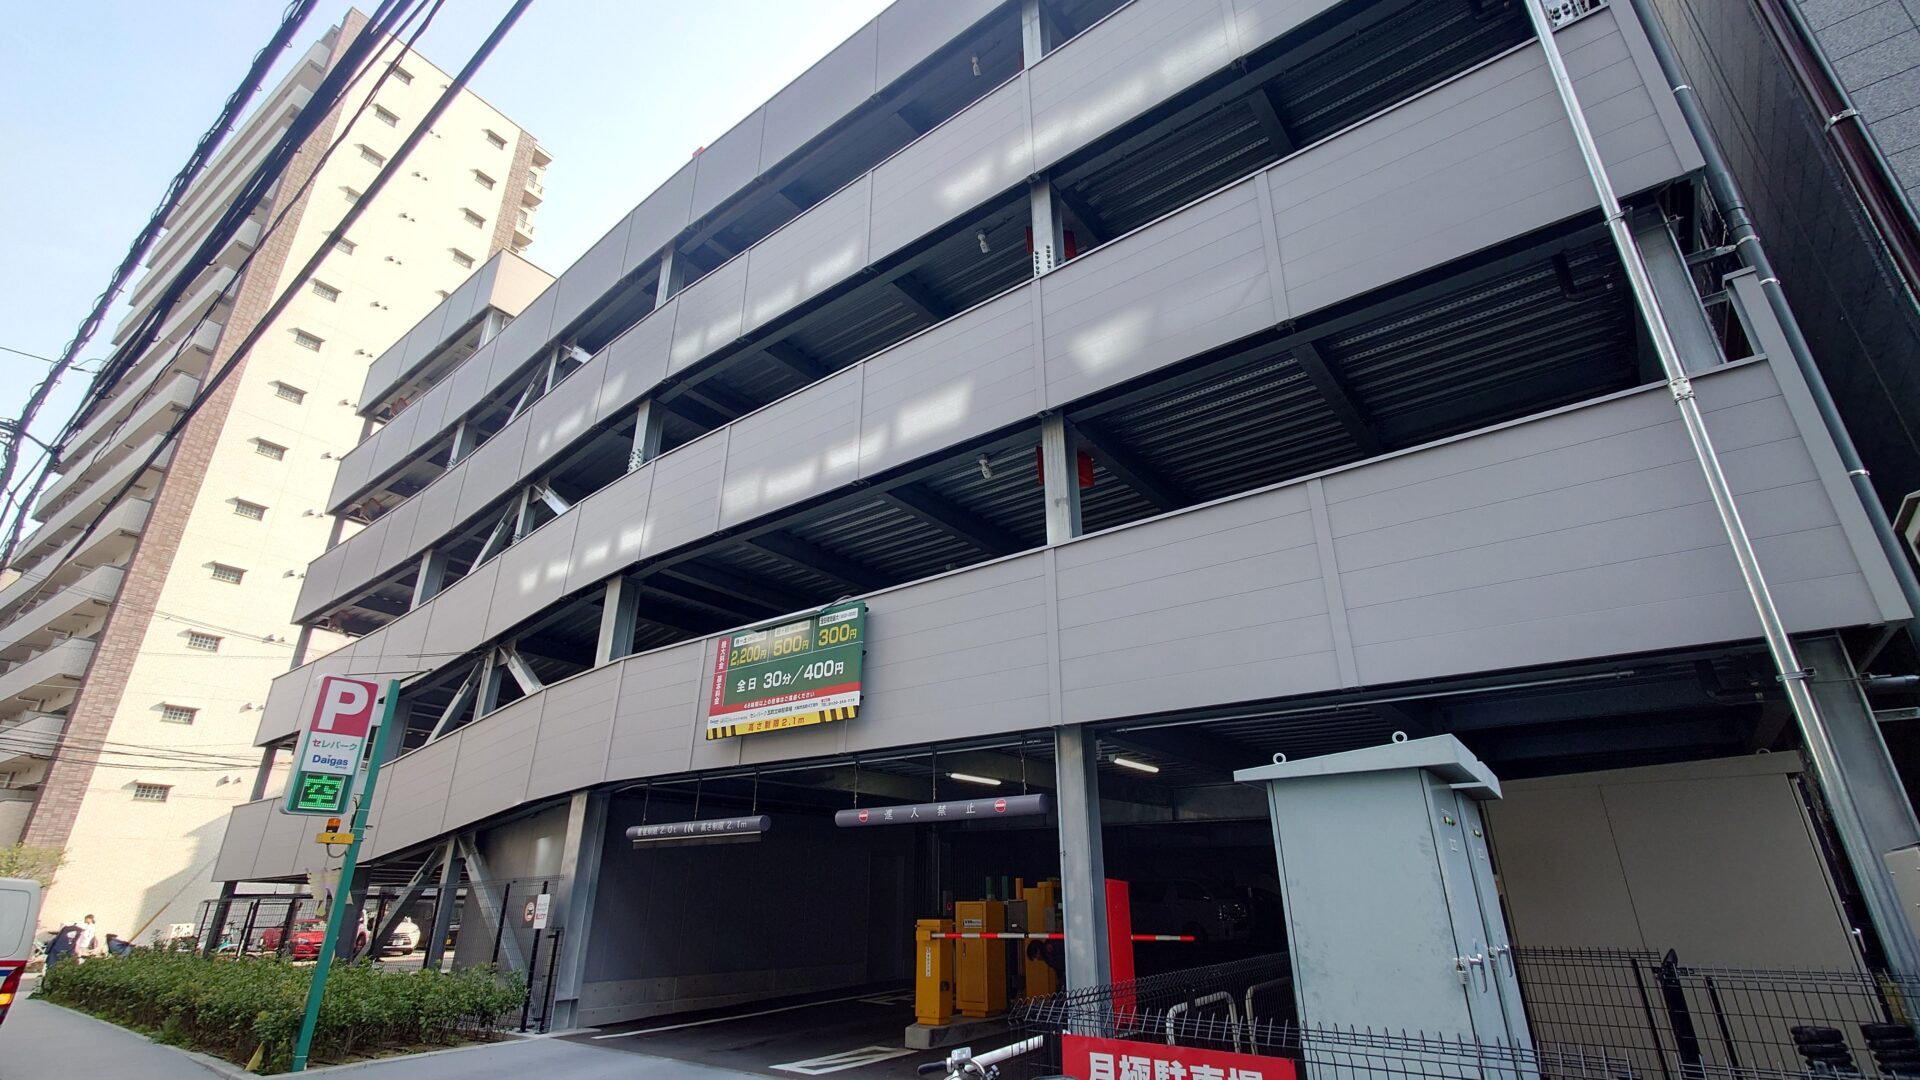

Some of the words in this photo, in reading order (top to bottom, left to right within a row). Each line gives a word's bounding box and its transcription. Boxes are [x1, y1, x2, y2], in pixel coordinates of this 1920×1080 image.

[773, 635, 809, 657] 500円
[818, 624, 857, 647] 300円
[730, 644, 767, 667] 2,200円
[736, 677, 757, 693] 全日
[318, 679, 369, 731] P
[312, 754, 349, 767] Daigas
[300, 775, 342, 808] 空
[684, 823, 695, 833] IN
